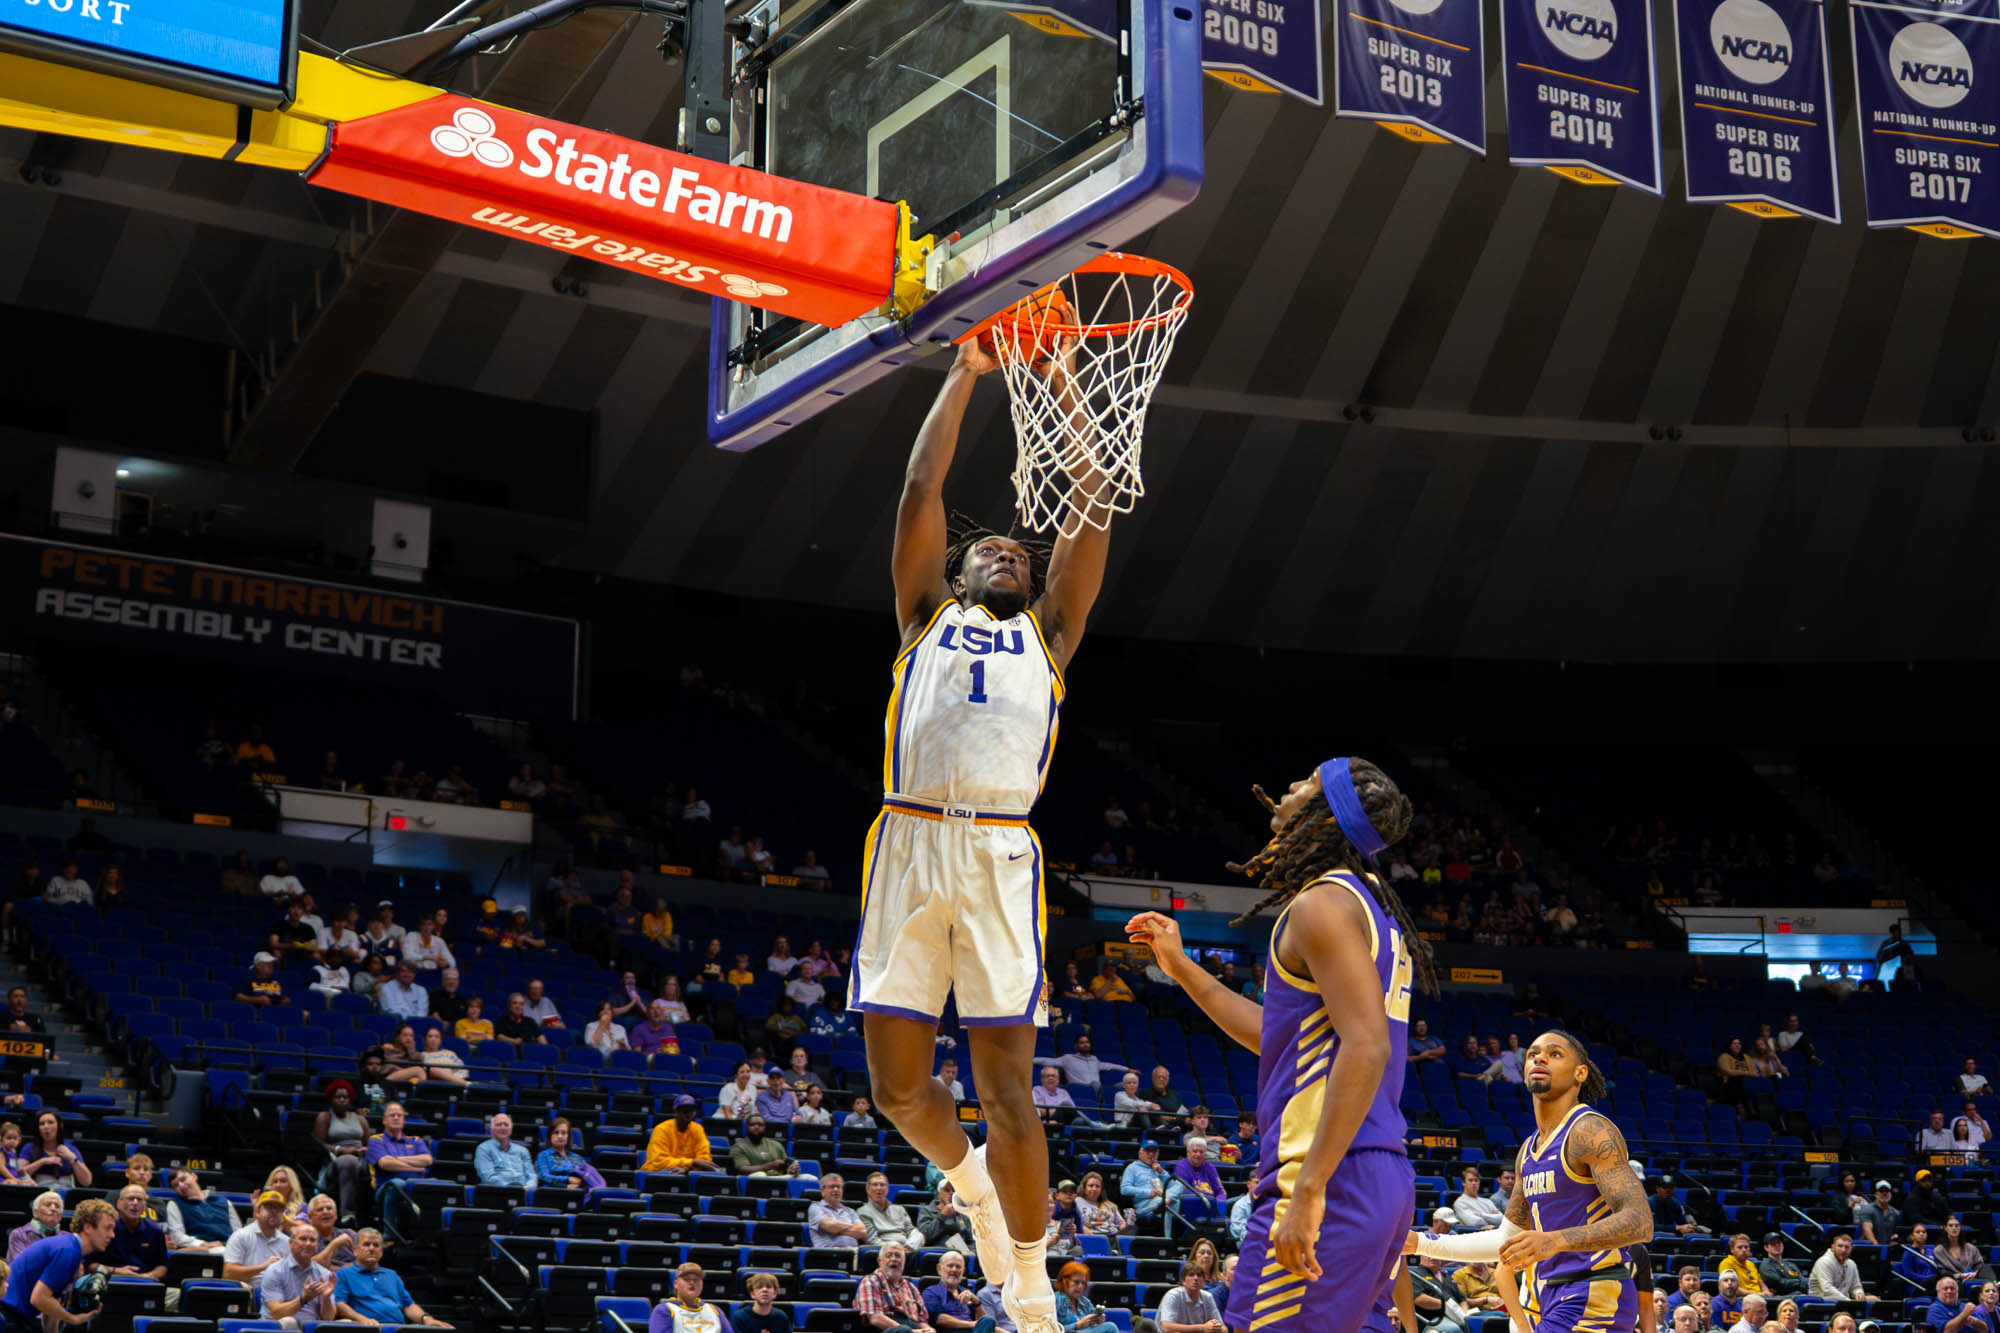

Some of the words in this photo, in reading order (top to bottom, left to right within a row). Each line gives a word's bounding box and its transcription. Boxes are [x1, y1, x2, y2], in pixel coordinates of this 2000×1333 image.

[1257, 1, 1284, 24] SIX
[1546, 7, 1615, 43] NCAA
[1205, 9, 1278, 56] 2009
[1368, 37, 1420, 67] SUPER
[1425, 56, 1452, 77] SIX
[1721, 34, 1790, 66] NCAA
[1380, 65, 1442, 107] 2013
[1900, 60, 1971, 89] NCAA
[1537, 84, 1590, 111] SUPER
[1596, 98, 1622, 119] SIX
[1695, 84, 1749, 104] NATIONAL
[1752, 94, 1815, 114] RUNNER-UP
[1550, 111, 1614, 149] 2014
[1716, 123, 1768, 147] SUPER
[1774, 132, 1800, 152] SIX
[1874, 111, 1928, 127] NATIONAL
[1933, 117, 1997, 136] RUNNER-UP
[1729, 148, 1792, 182] 2016
[1895, 148, 1950, 170] SUPER
[1955, 156, 1982, 174] SIX
[1910, 172, 1971, 203] 2017
[1754, 204, 1772, 214] LSU
[40, 547, 176, 596] PETE
[191, 571, 446, 633] MARAVICH
[34, 587, 272, 644] ASSEMBLY
[285, 623, 443, 669] CENTER
[938, 624, 1025, 655] LSU
[968, 660, 987, 703] 1
[947, 808, 972, 819] LSU
[3, 1043, 35, 1055] 102
